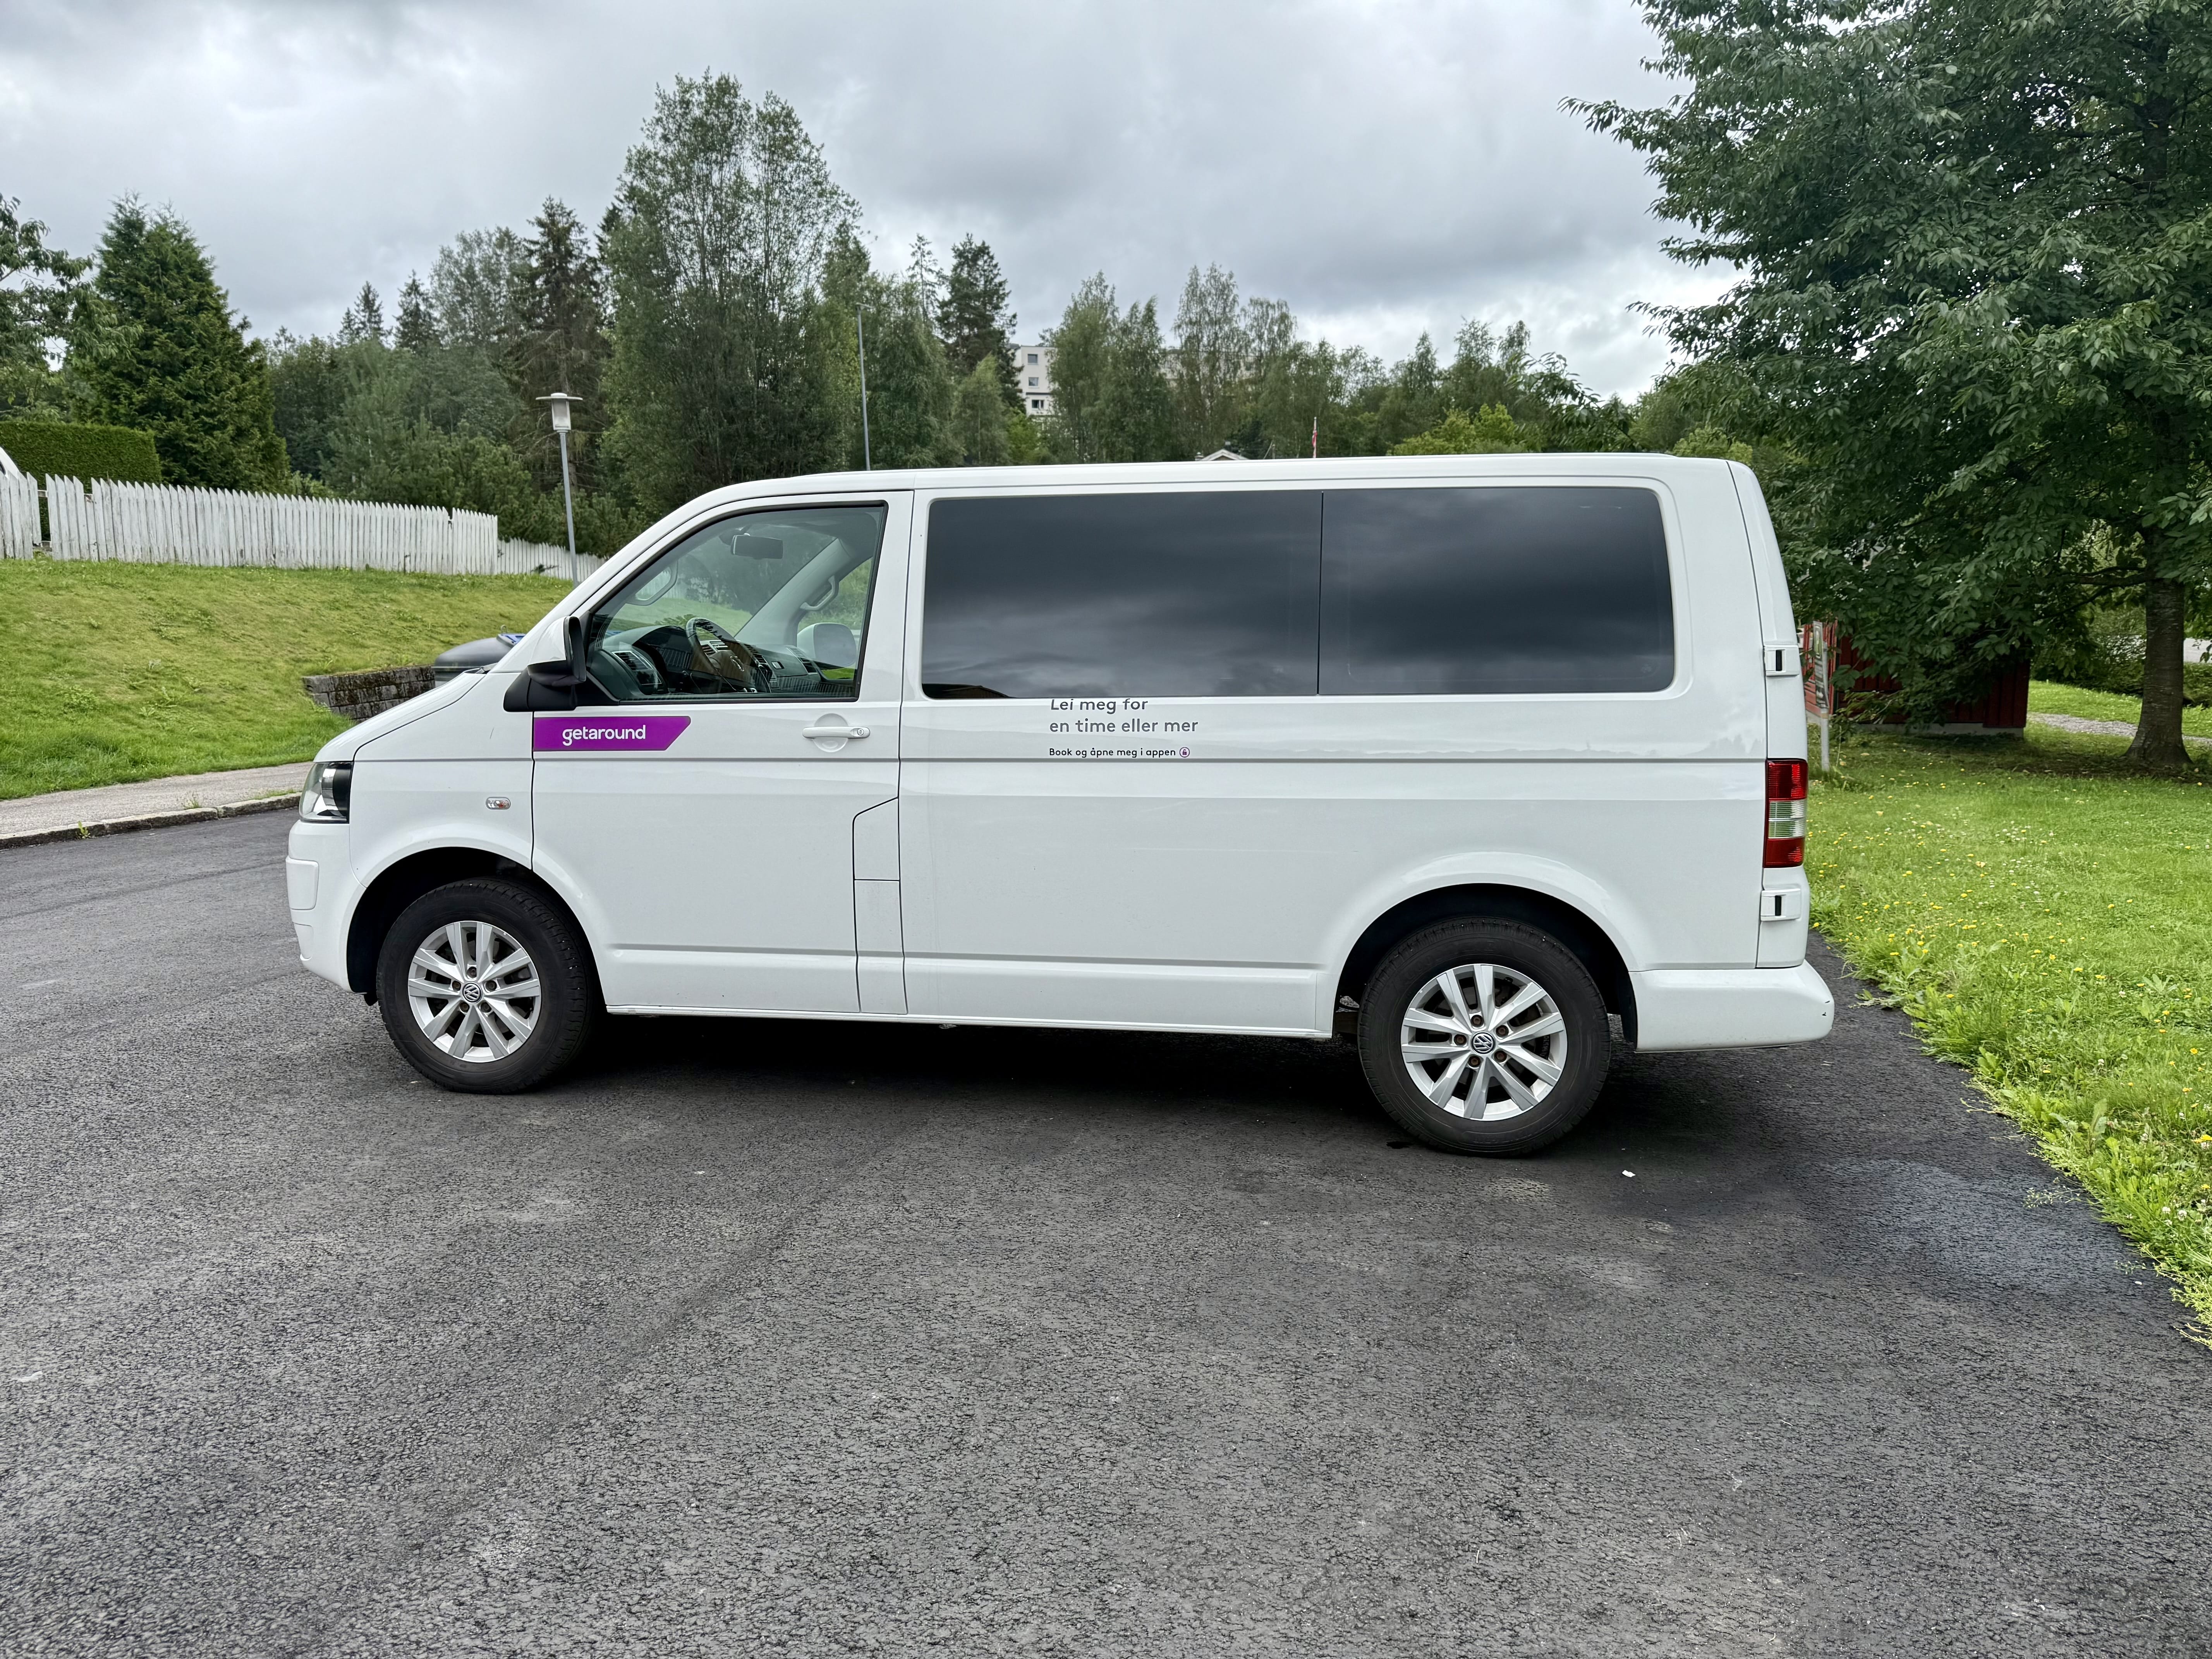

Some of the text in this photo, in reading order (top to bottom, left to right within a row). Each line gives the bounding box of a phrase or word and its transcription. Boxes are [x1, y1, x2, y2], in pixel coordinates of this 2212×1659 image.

[1051, 698, 1148, 714] Lei meg for
[1050, 718, 1199, 732] en time eller mer
[562, 725, 646, 746] getaround
[1090, 747, 1114, 758] åpne
[1140, 748, 1143, 756] i
[1146, 750, 1176, 758] appen
